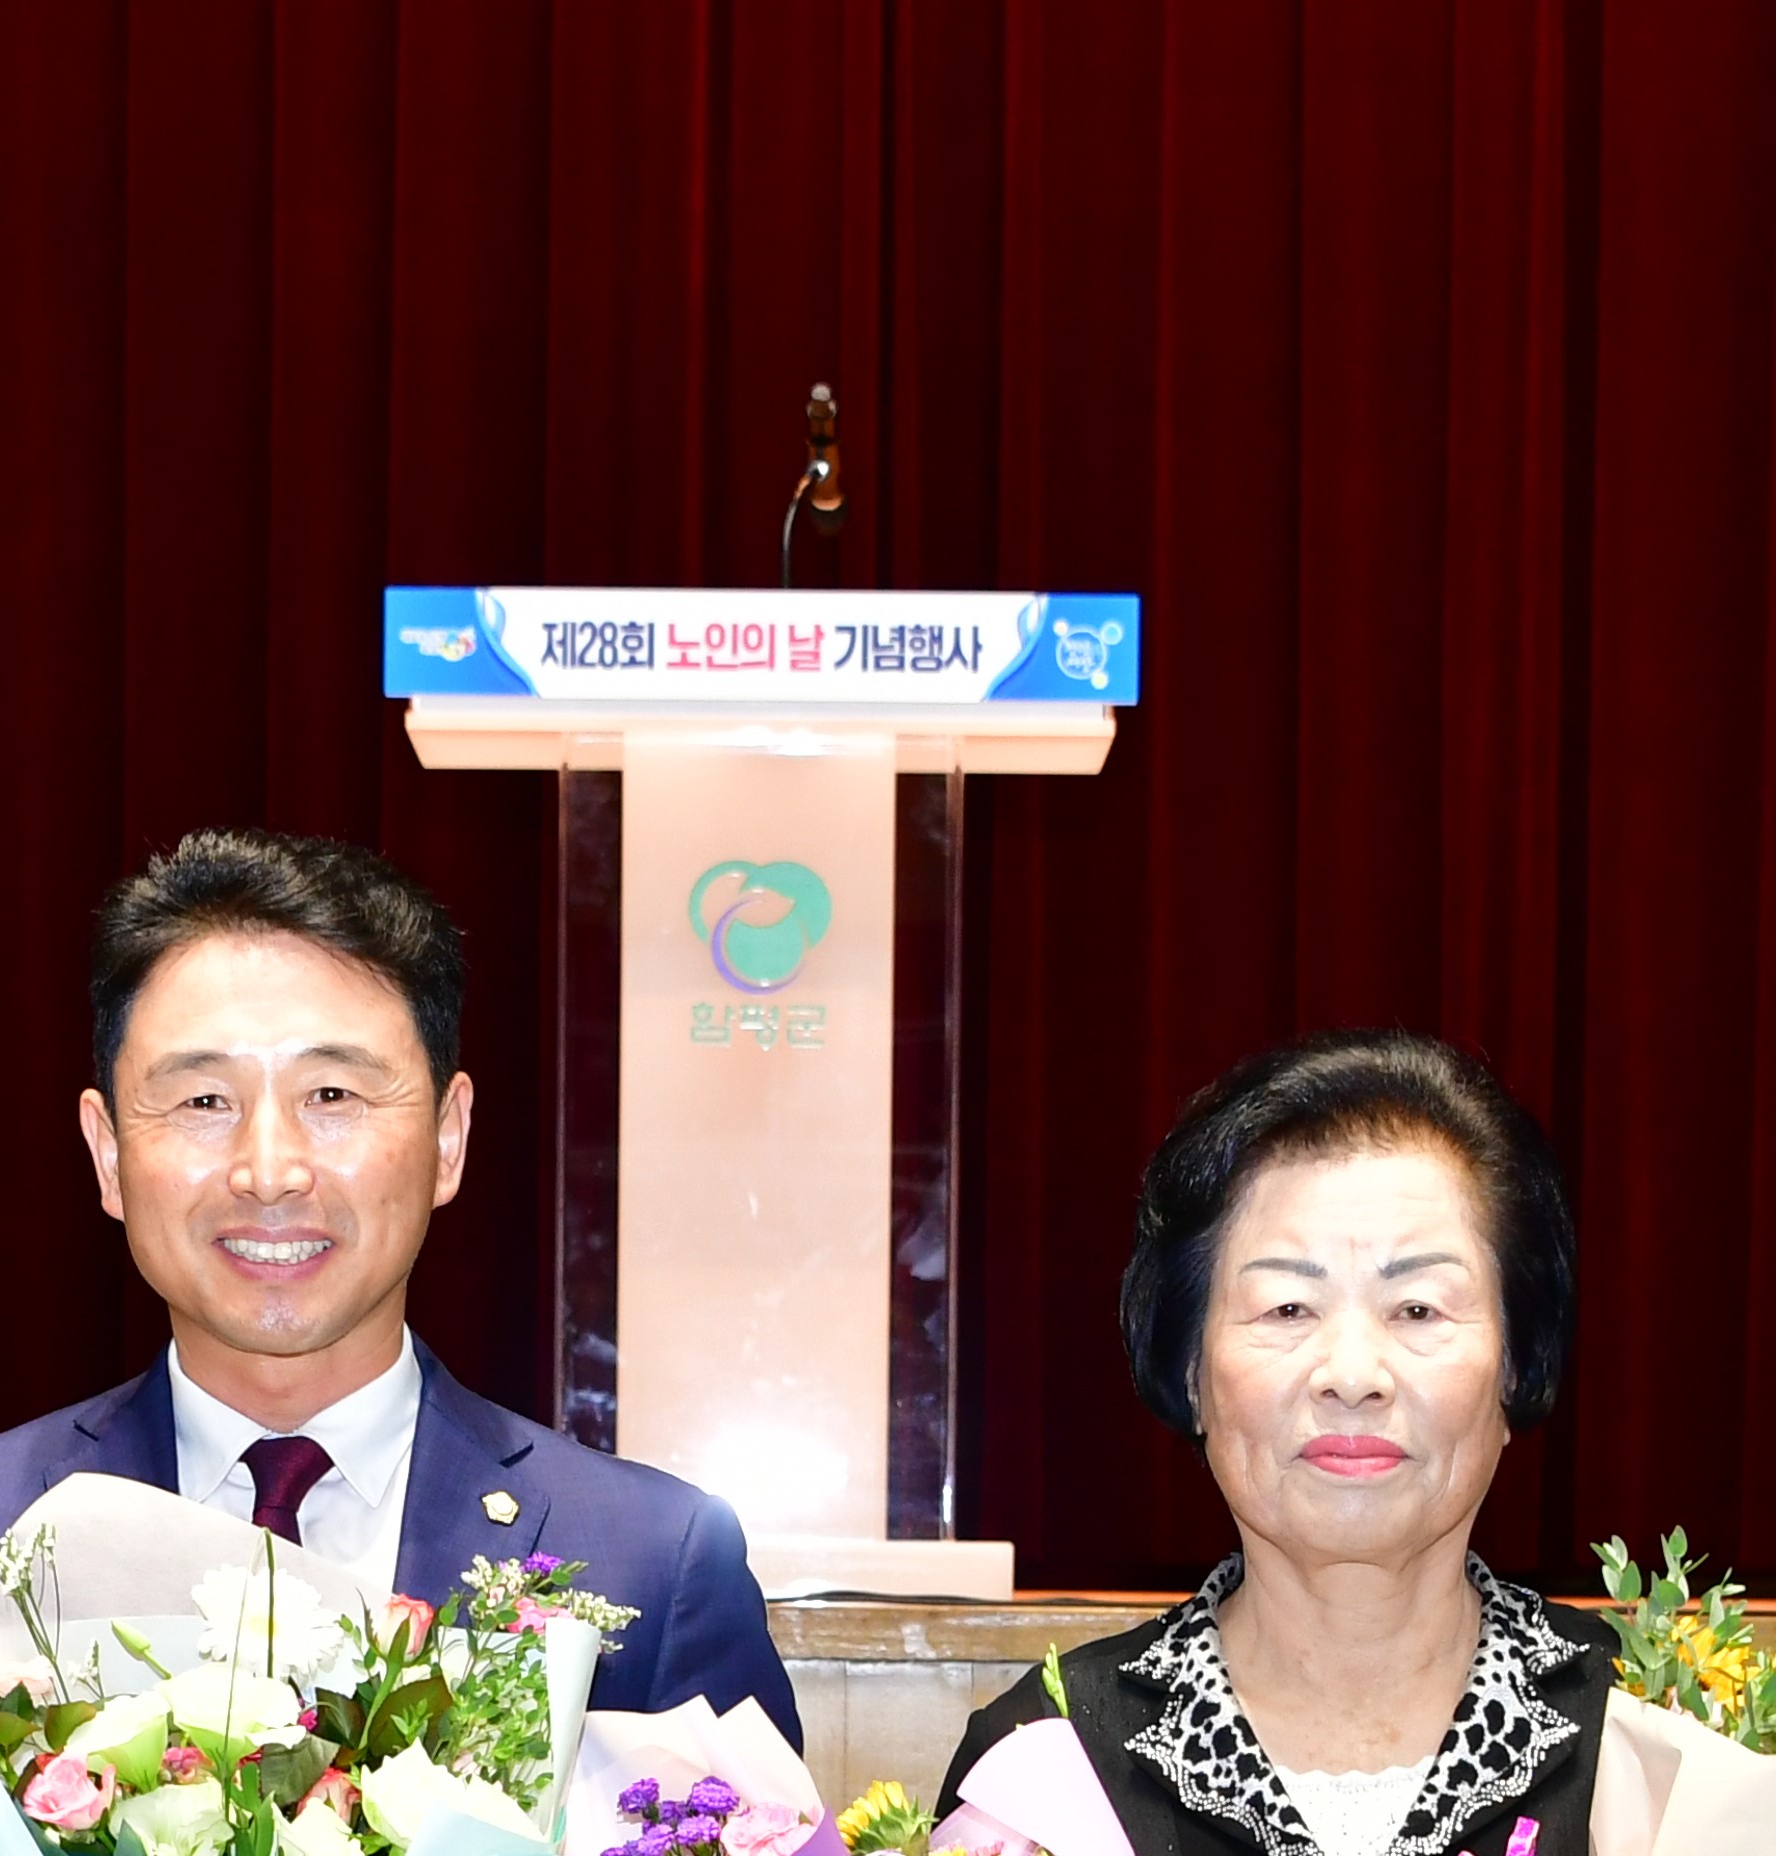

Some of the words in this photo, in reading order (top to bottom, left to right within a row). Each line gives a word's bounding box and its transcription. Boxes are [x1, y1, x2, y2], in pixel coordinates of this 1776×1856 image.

[540, 620, 655, 671] 제28회
[666, 621, 777, 671] 노인의
[787, 622, 824, 673] 날
[833, 624, 983, 674] 기념행사
[691, 1001, 827, 1052] 함평군
